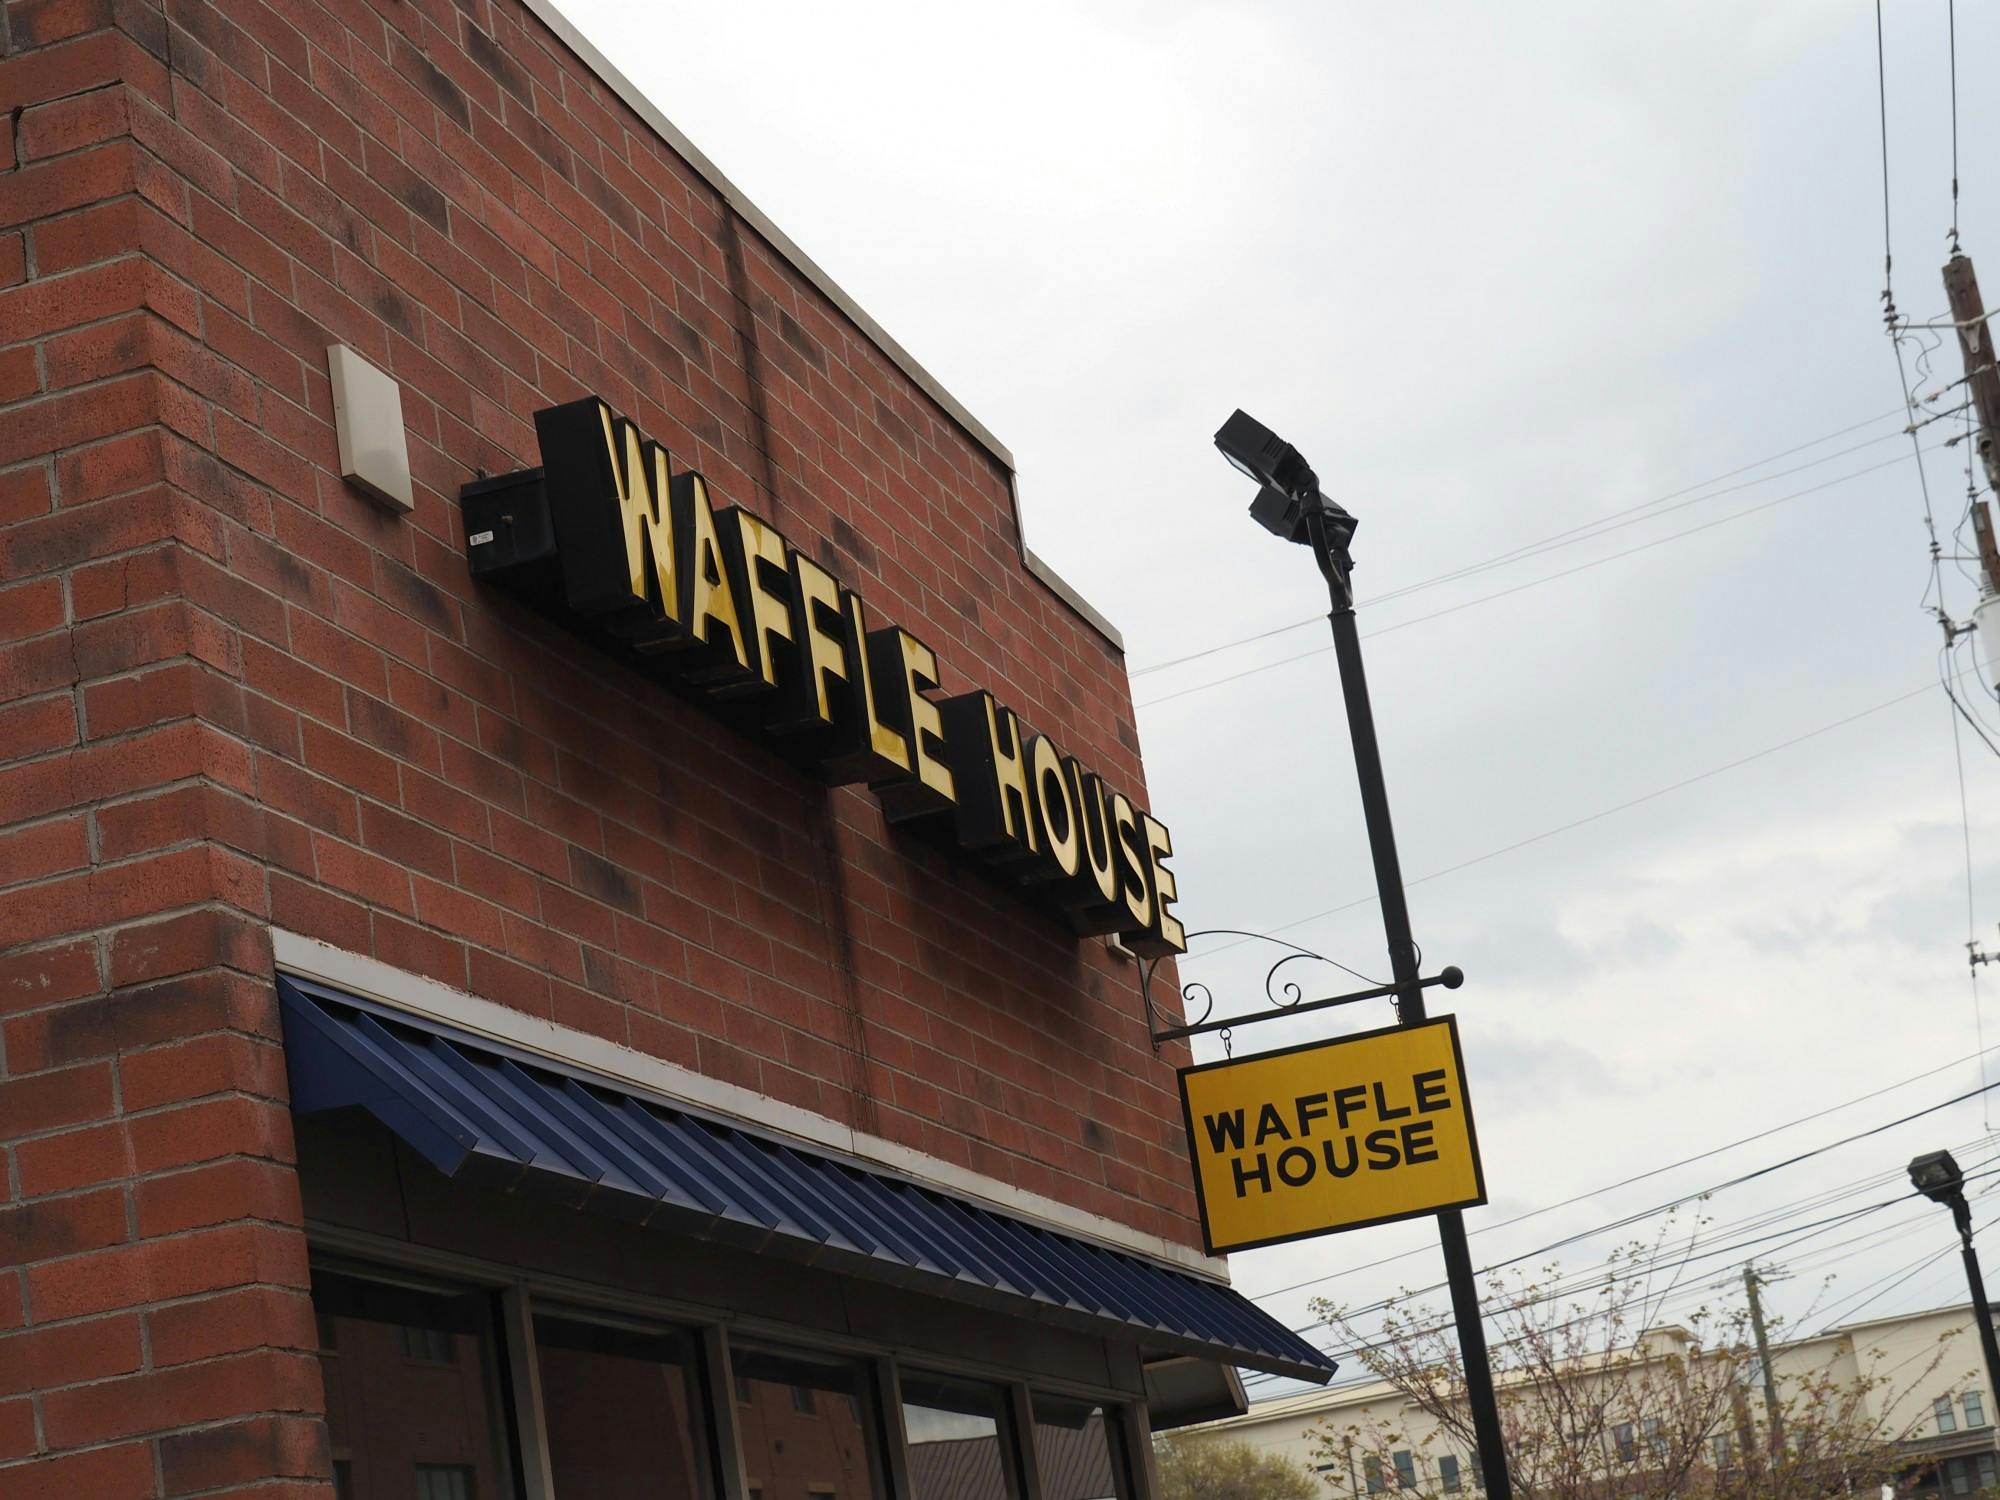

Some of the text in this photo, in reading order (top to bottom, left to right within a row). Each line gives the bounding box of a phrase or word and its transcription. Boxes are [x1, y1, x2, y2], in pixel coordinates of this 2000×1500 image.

[598, 402, 1187, 954] WAFFLE HOUSE
[1203, 1068, 1452, 1154] WAFFLE
[1231, 1120, 1439, 1198] HOUSE
